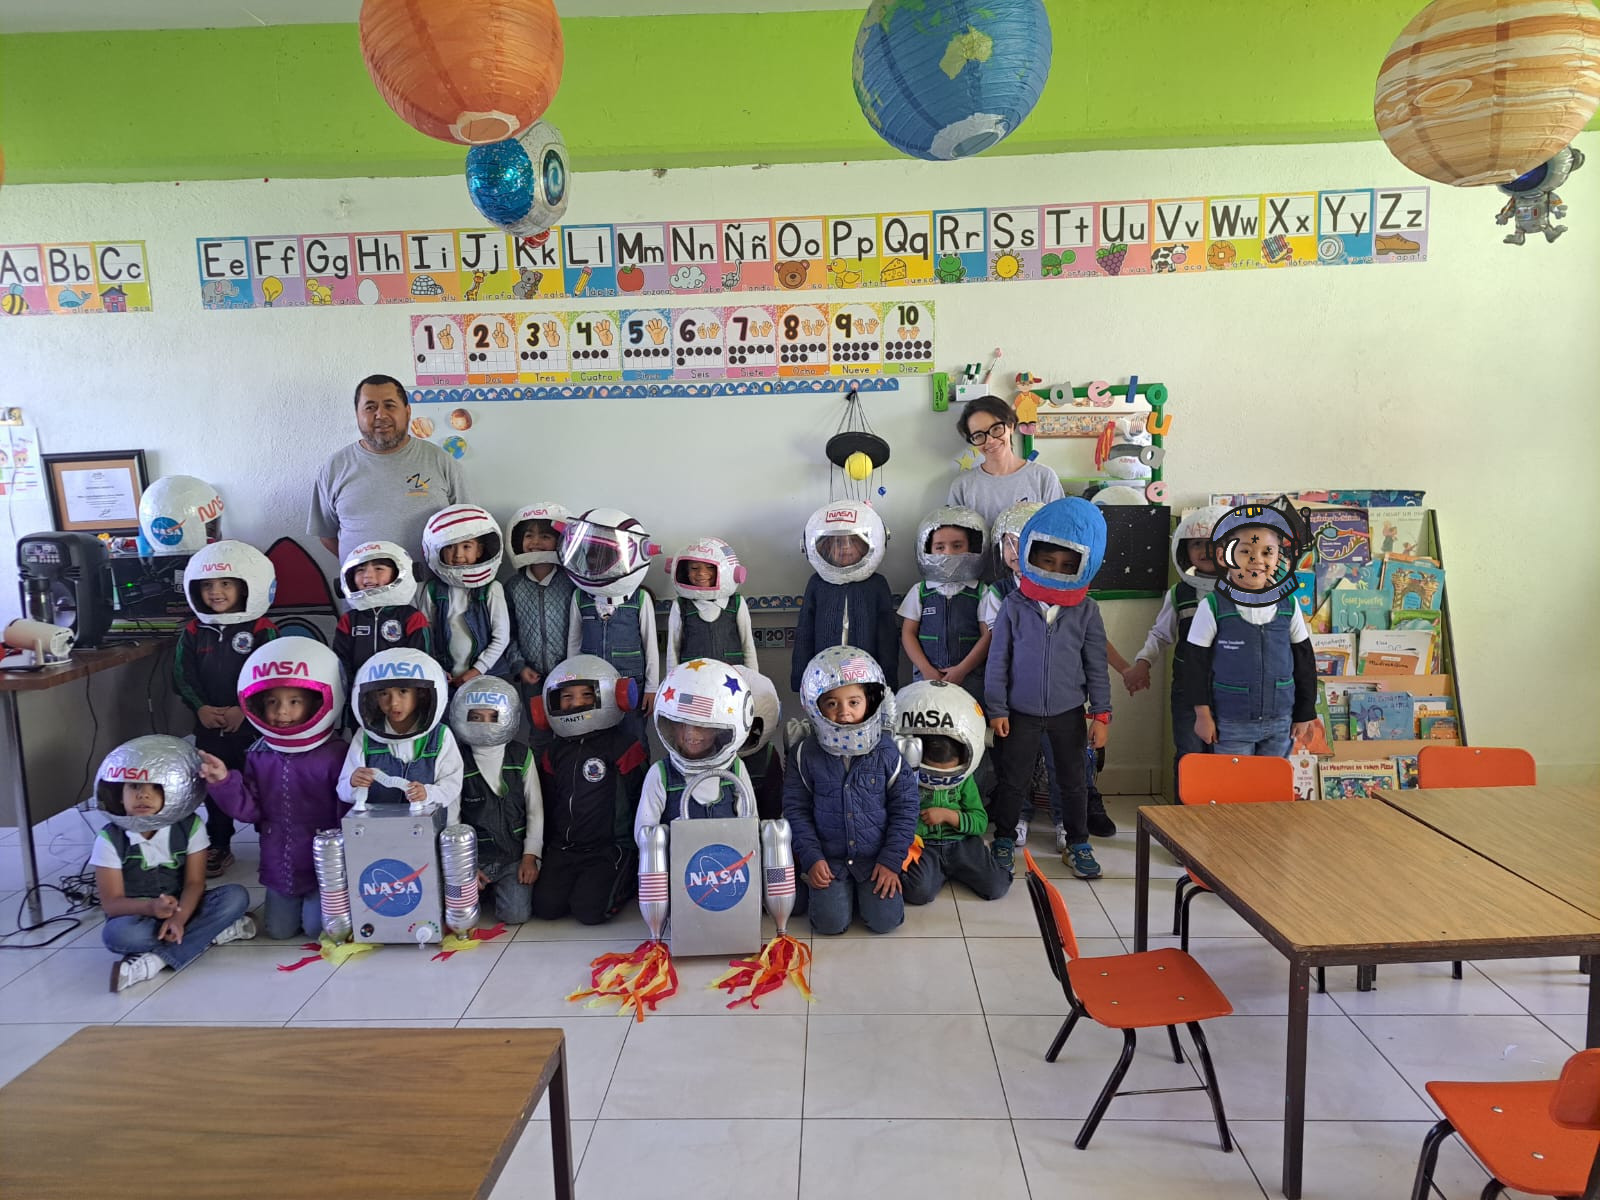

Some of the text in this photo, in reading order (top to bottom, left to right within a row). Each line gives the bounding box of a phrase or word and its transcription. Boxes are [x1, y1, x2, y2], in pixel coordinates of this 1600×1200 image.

[203, 242, 244, 278] Ee
[255, 241, 296, 275] Ff
[306, 239, 348, 279] Gg
[357, 238, 400, 271] Hh
[411, 236, 447, 269] Ii
[461, 233, 499, 274] Jj
[617, 232, 664, 264] Mm
[671, 227, 714, 262] Nn
[724, 223, 767, 261] Ññ
[778, 222, 820, 257] Oo
[833, 220, 874, 261] Pp
[884, 218, 929, 260] Qq
[940, 215, 980, 250] Rr
[993, 212, 1035, 249] Ss
[1046, 209, 1089, 245] Tt
[1102, 206, 1144, 242] Uu
[1157, 204, 1199, 240] Vv
[1211, 204, 1258, 237] Ww
[1268, 198, 1309, 234] Xx
[1325, 195, 1367, 237] Yy
[1379, 193, 1422, 229] Zz
[0, 246, 141, 283] Aa Bb Cc
[638, 288, 670, 296] anzana
[424, 305, 919, 349] 1 2 3 4 5 6 7 8 9 10
[432, 375, 450, 385] Uno
[485, 375, 501, 384] Dos
[536, 373, 555, 382] Tres
[580, 372, 613, 382] Cuatro
[691, 369, 710, 379] Seis
[740, 368, 764, 378] Siete
[793, 367, 816, 375] Ocho
[842, 364, 870, 374] Nueve
[899, 364, 919, 373] Diez
[197, 495, 224, 522] NAS
[522, 508, 549, 518] NASA
[828, 511, 854, 519] NASA
[353, 544, 381, 556] NASA
[687, 544, 714, 555] NASA
[202, 563, 232, 572] NASA
[767, 630, 784, 641] 20
[252, 661, 309, 680] NASA
[368, 662, 425, 680] NASA
[843, 670, 868, 680] NASA
[466, 692, 509, 705] NASA
[902, 710, 954, 728] NASA
[107, 767, 149, 781] NASA
[690, 870, 747, 885] NASA
[363, 881, 419, 896] NASA
